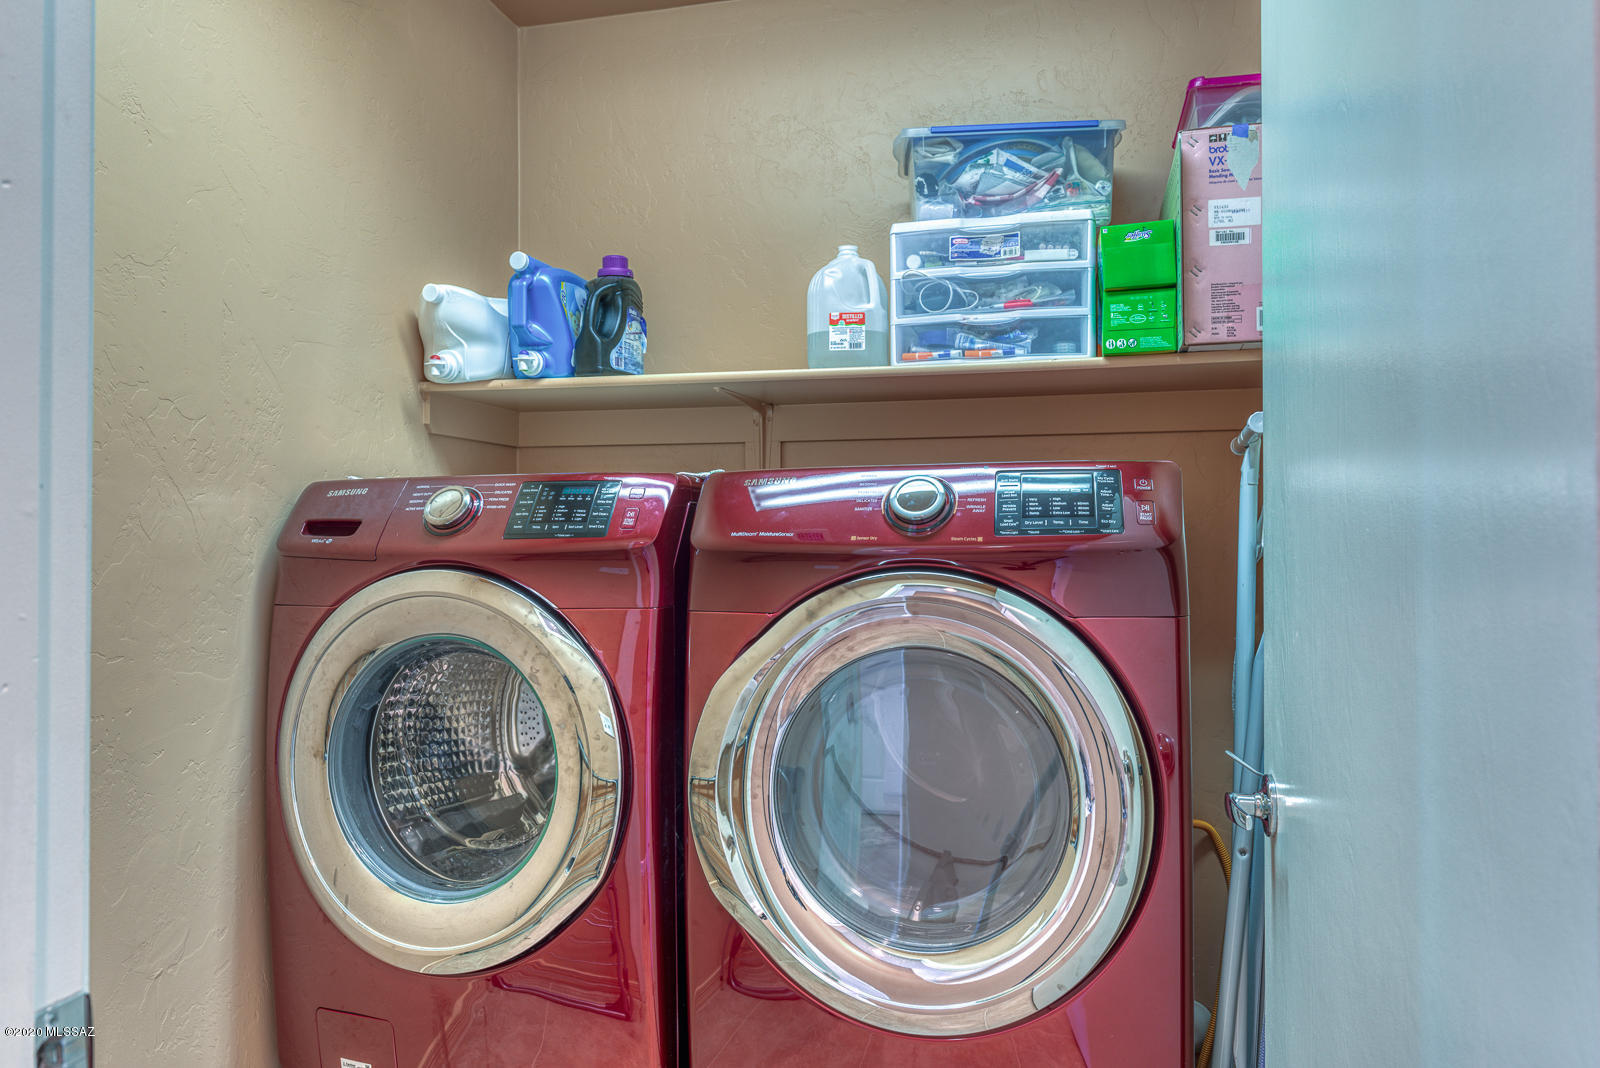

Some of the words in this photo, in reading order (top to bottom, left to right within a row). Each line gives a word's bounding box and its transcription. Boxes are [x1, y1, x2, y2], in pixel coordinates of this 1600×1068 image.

[1208, 144, 1229, 154] brot
[1208, 155, 1227, 166] VX-
[744, 476, 797, 487] SAMSUNG
[327, 487, 369, 497] SAMSUNG
